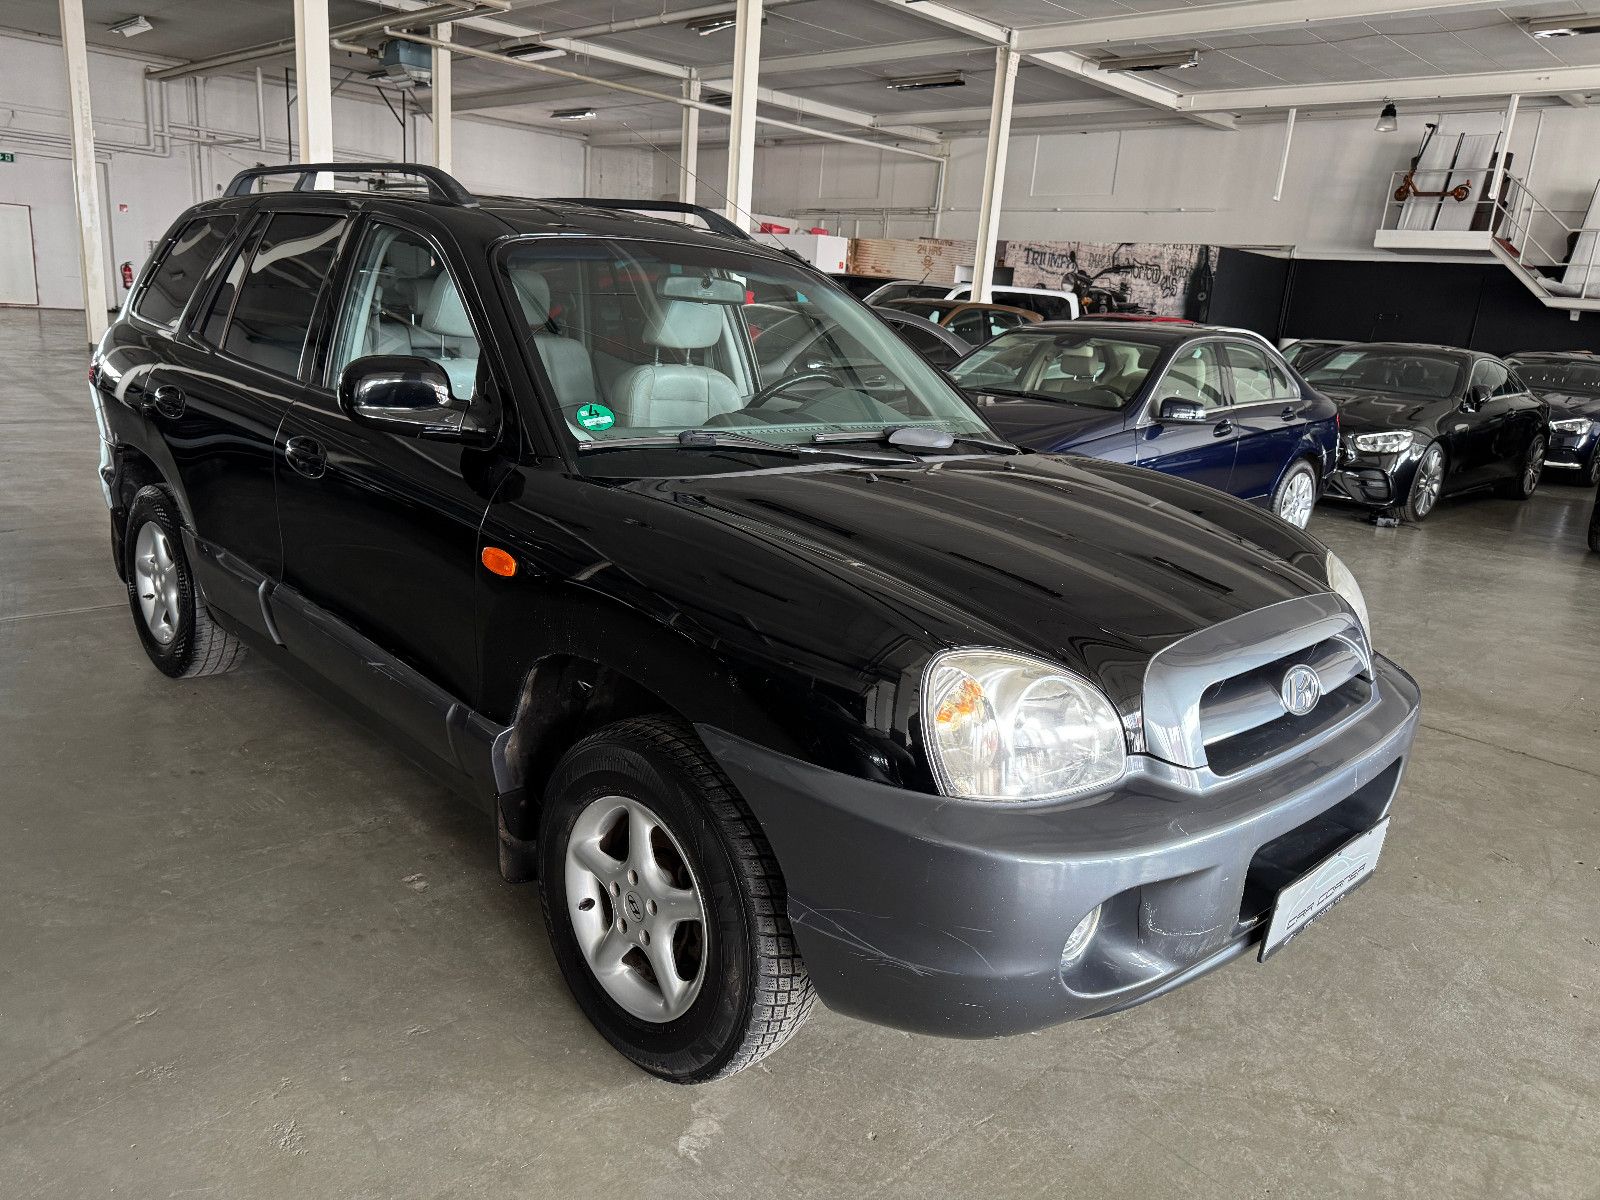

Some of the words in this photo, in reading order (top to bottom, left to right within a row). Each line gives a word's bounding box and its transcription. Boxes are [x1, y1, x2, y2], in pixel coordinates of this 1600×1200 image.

[588, 404, 600, 417] 4
[1286, 901, 1315, 930] CAR
[1316, 862, 1367, 907] CORNER
